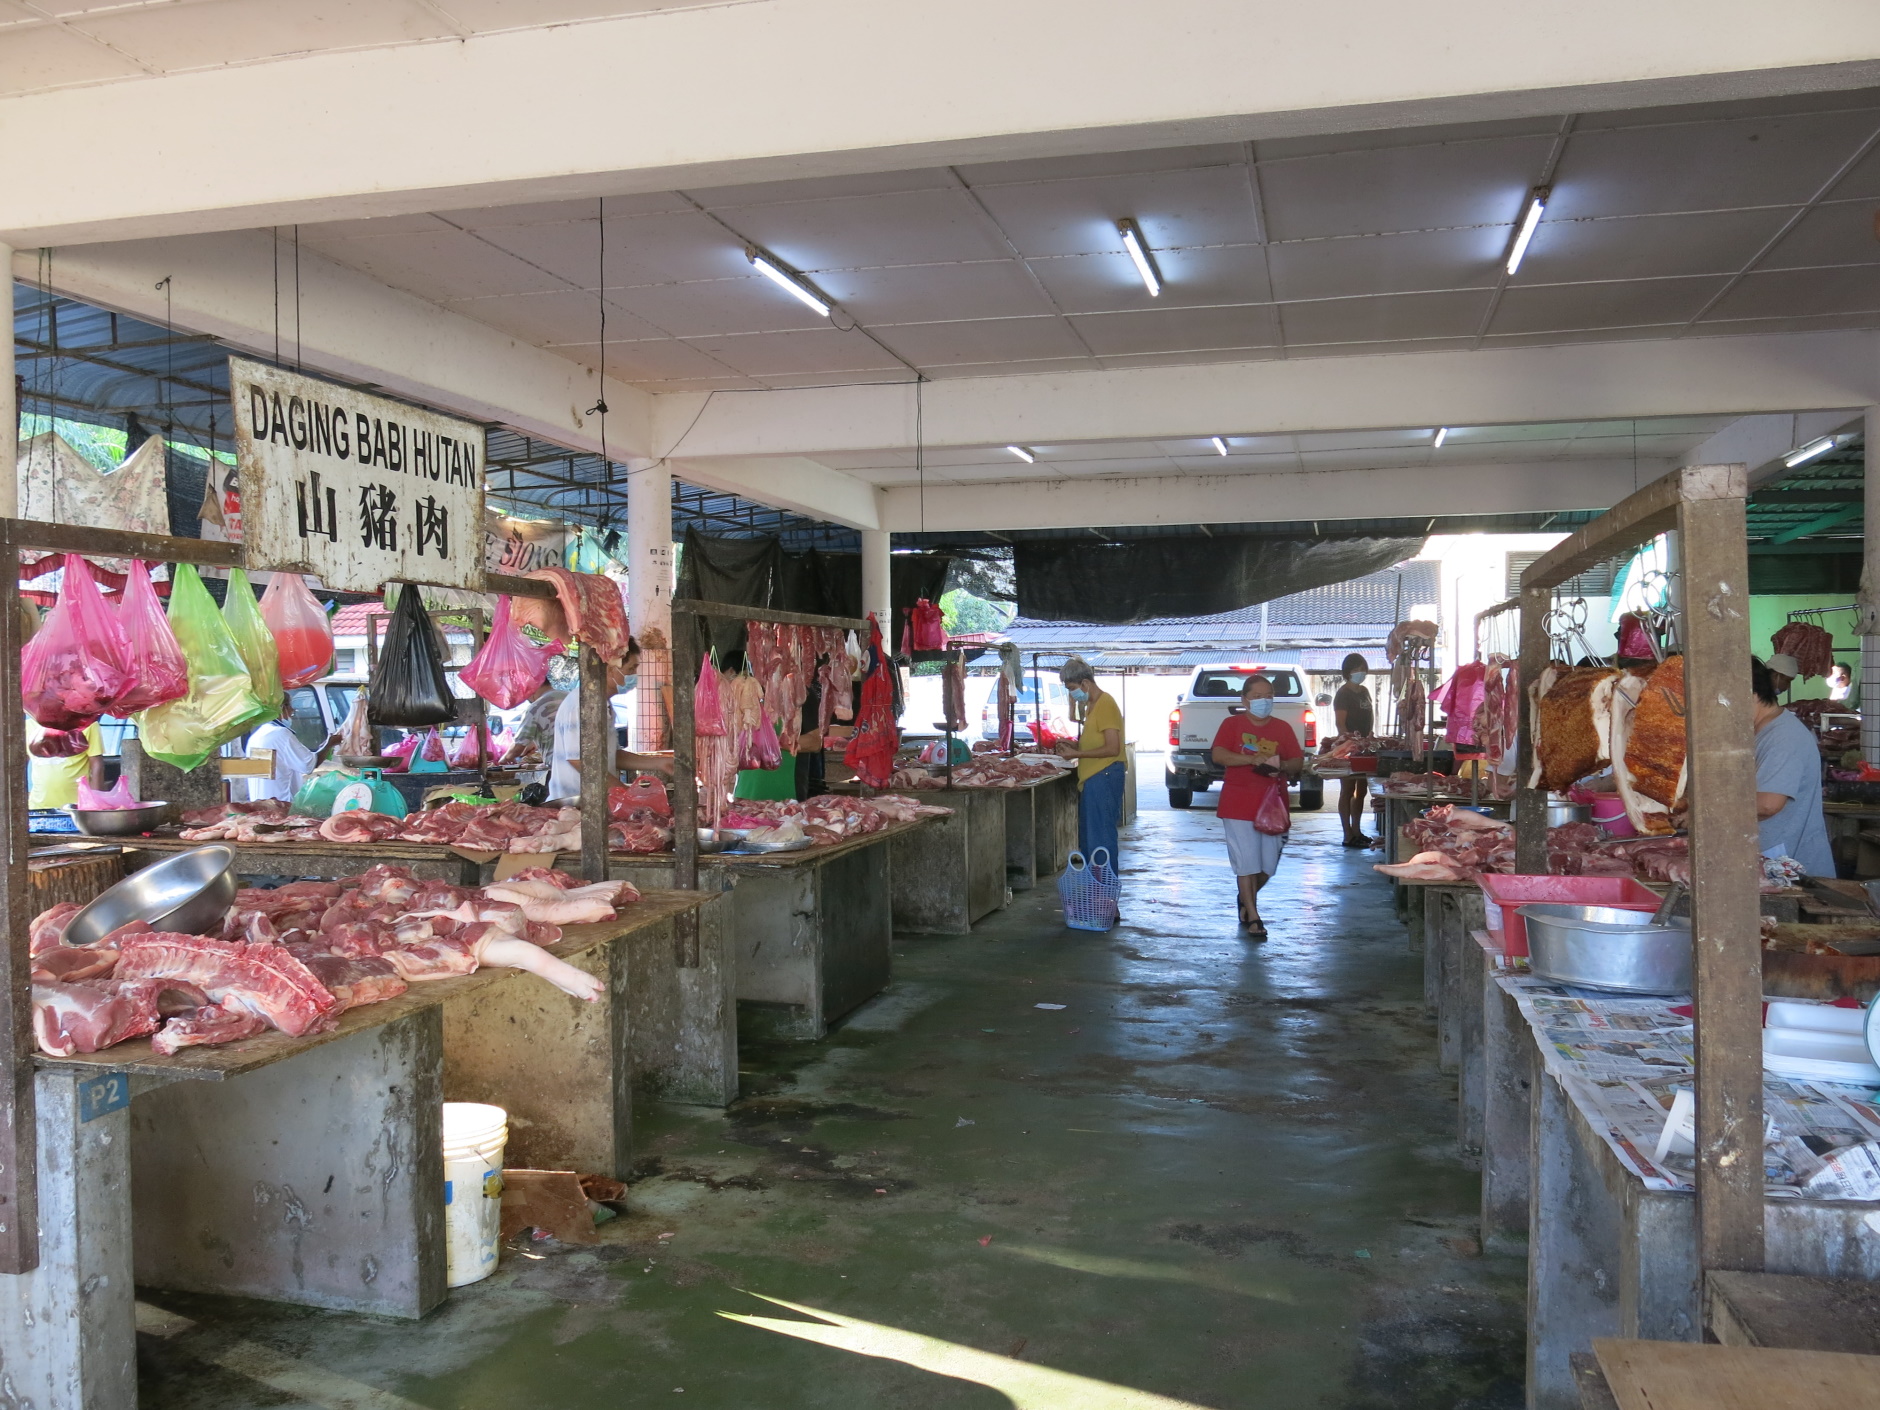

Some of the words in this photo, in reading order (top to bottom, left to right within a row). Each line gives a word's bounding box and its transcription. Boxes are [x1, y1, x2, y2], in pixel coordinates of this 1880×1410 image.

[250, 384, 349, 460] DAGING
[356, 412, 408, 474] BABI
[413, 428, 476, 489] HUTAN
[295, 470, 449, 560] 山豬肉
[91, 1079, 120, 1110] P2
